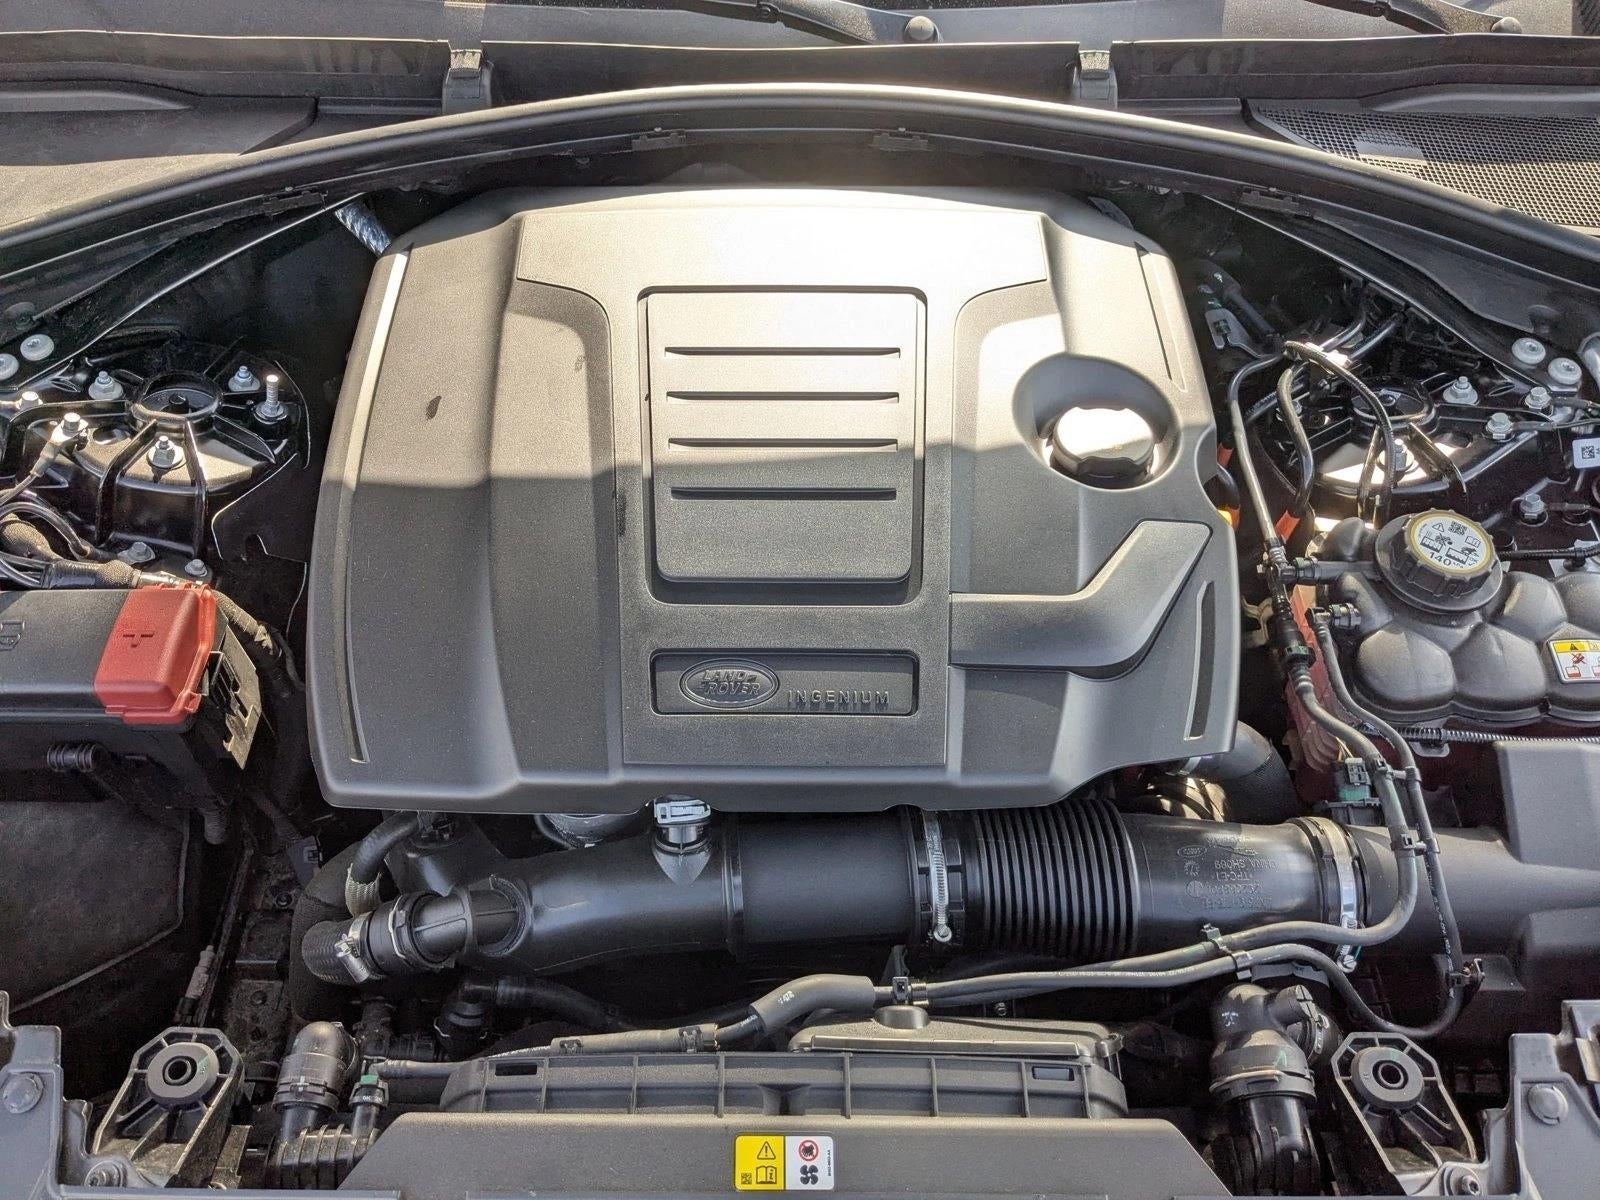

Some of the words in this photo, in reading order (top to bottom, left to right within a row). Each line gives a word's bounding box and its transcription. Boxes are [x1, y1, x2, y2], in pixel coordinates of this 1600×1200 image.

[1429, 551, 1452, 566] 140
[702, 669, 747, 681] LAND
[704, 682, 760, 695] ROVER
[787, 689, 890, 705] INGENIUM
